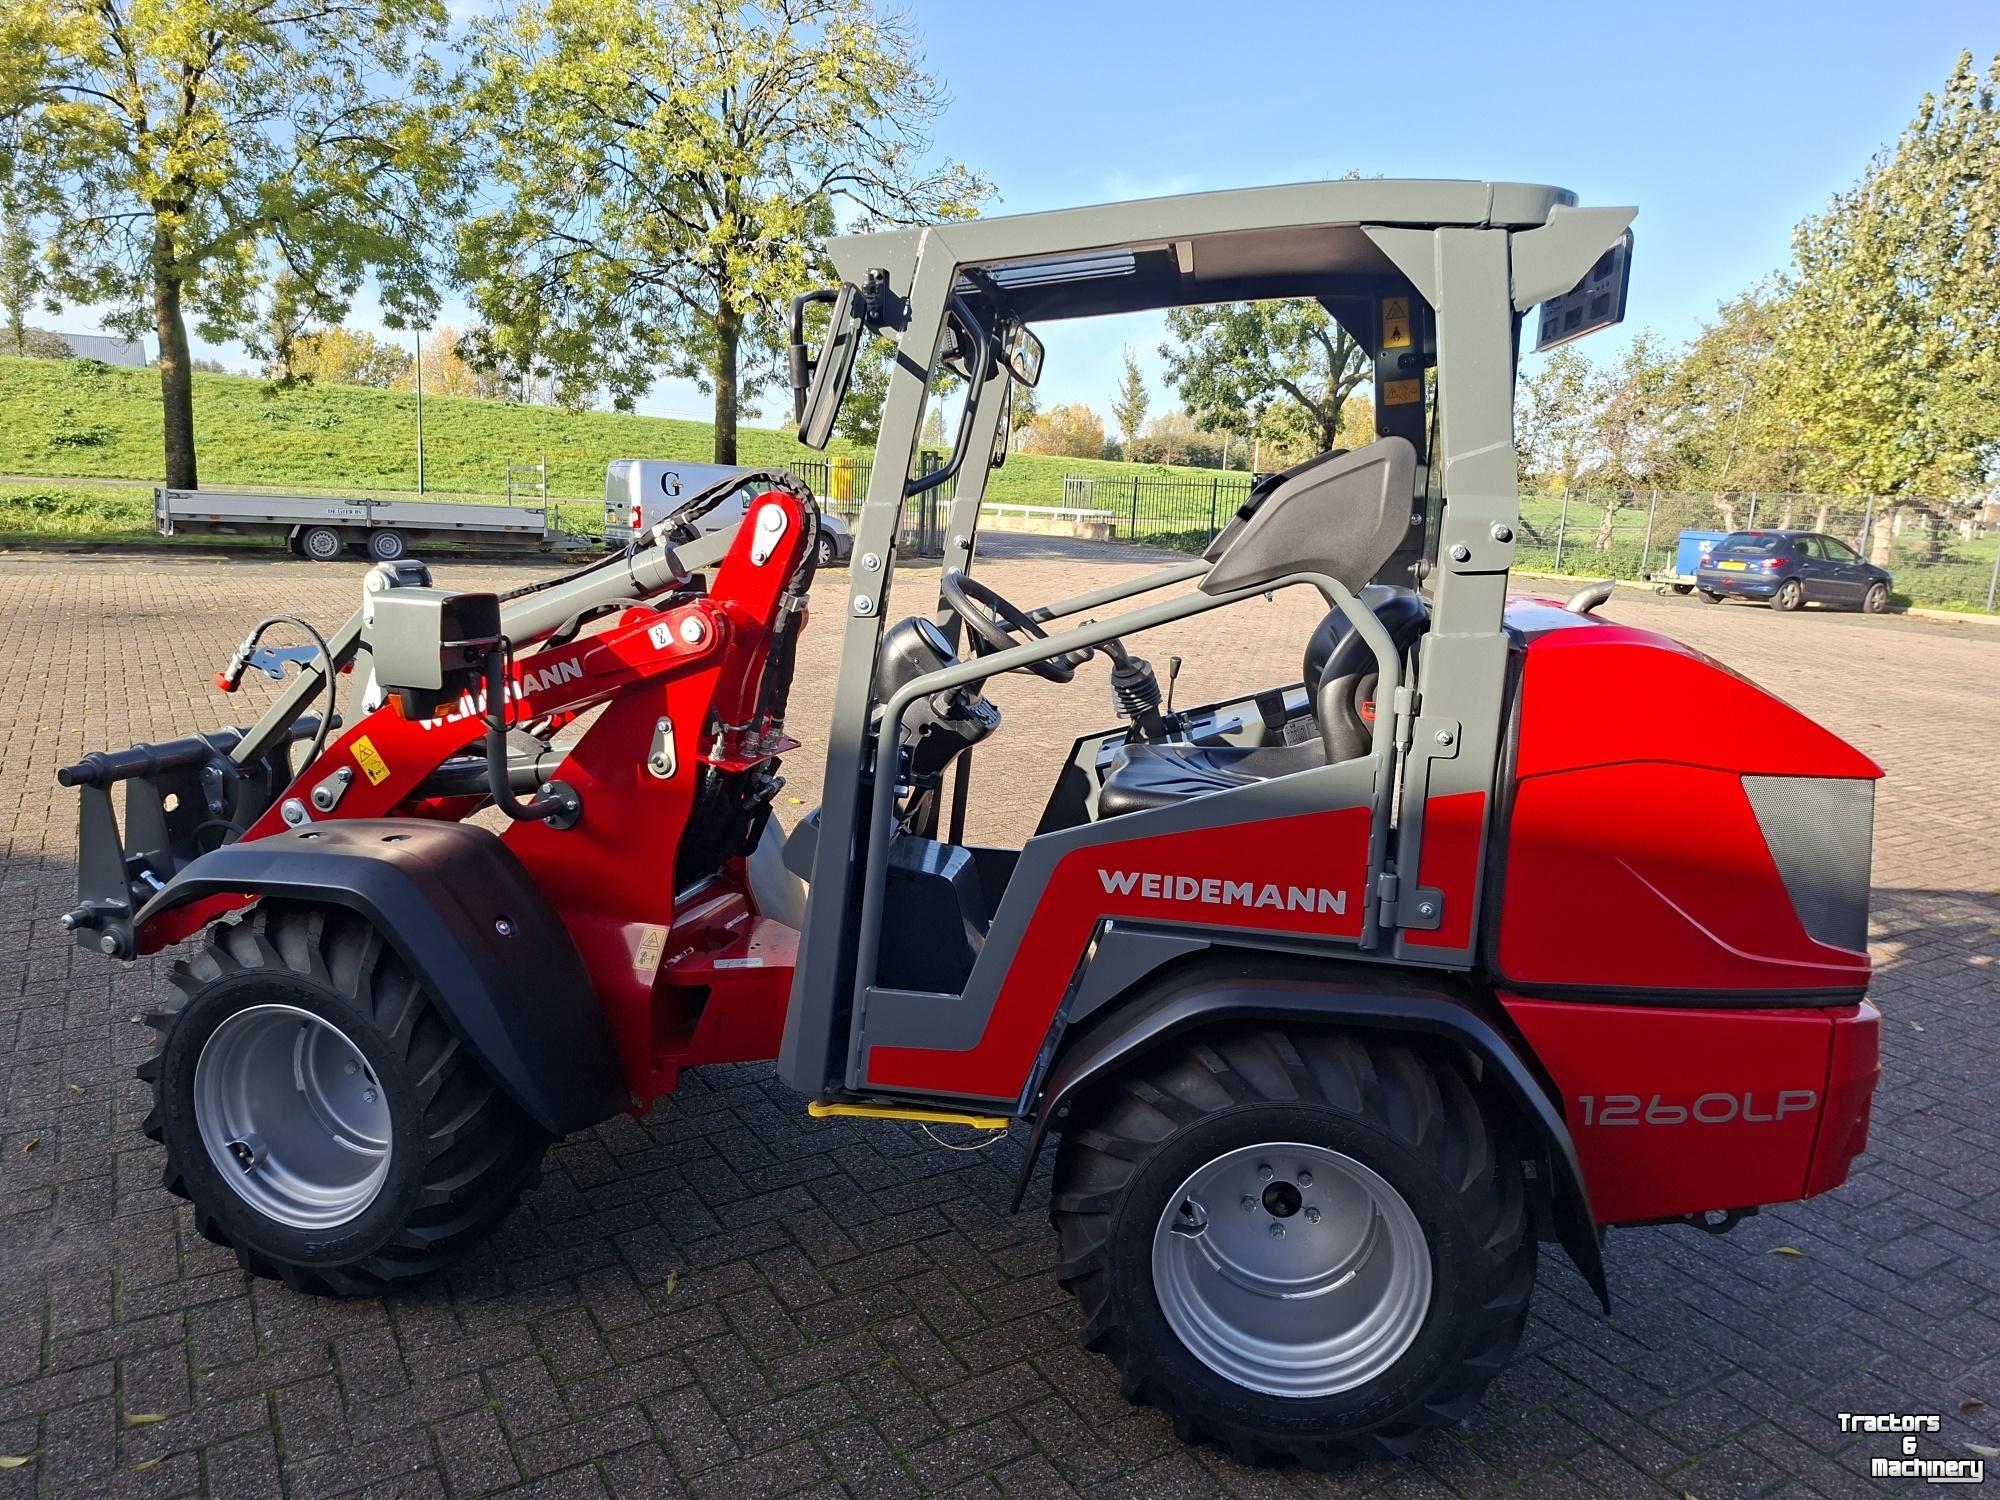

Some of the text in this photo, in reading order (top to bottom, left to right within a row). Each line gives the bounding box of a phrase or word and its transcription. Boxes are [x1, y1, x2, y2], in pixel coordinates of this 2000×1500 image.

[661, 471, 681, 497] G
[419, 657, 583, 731] IDMANN
[1098, 869, 1347, 915] WEIDEMANN
[1578, 1090, 1817, 1126] 1260LP
